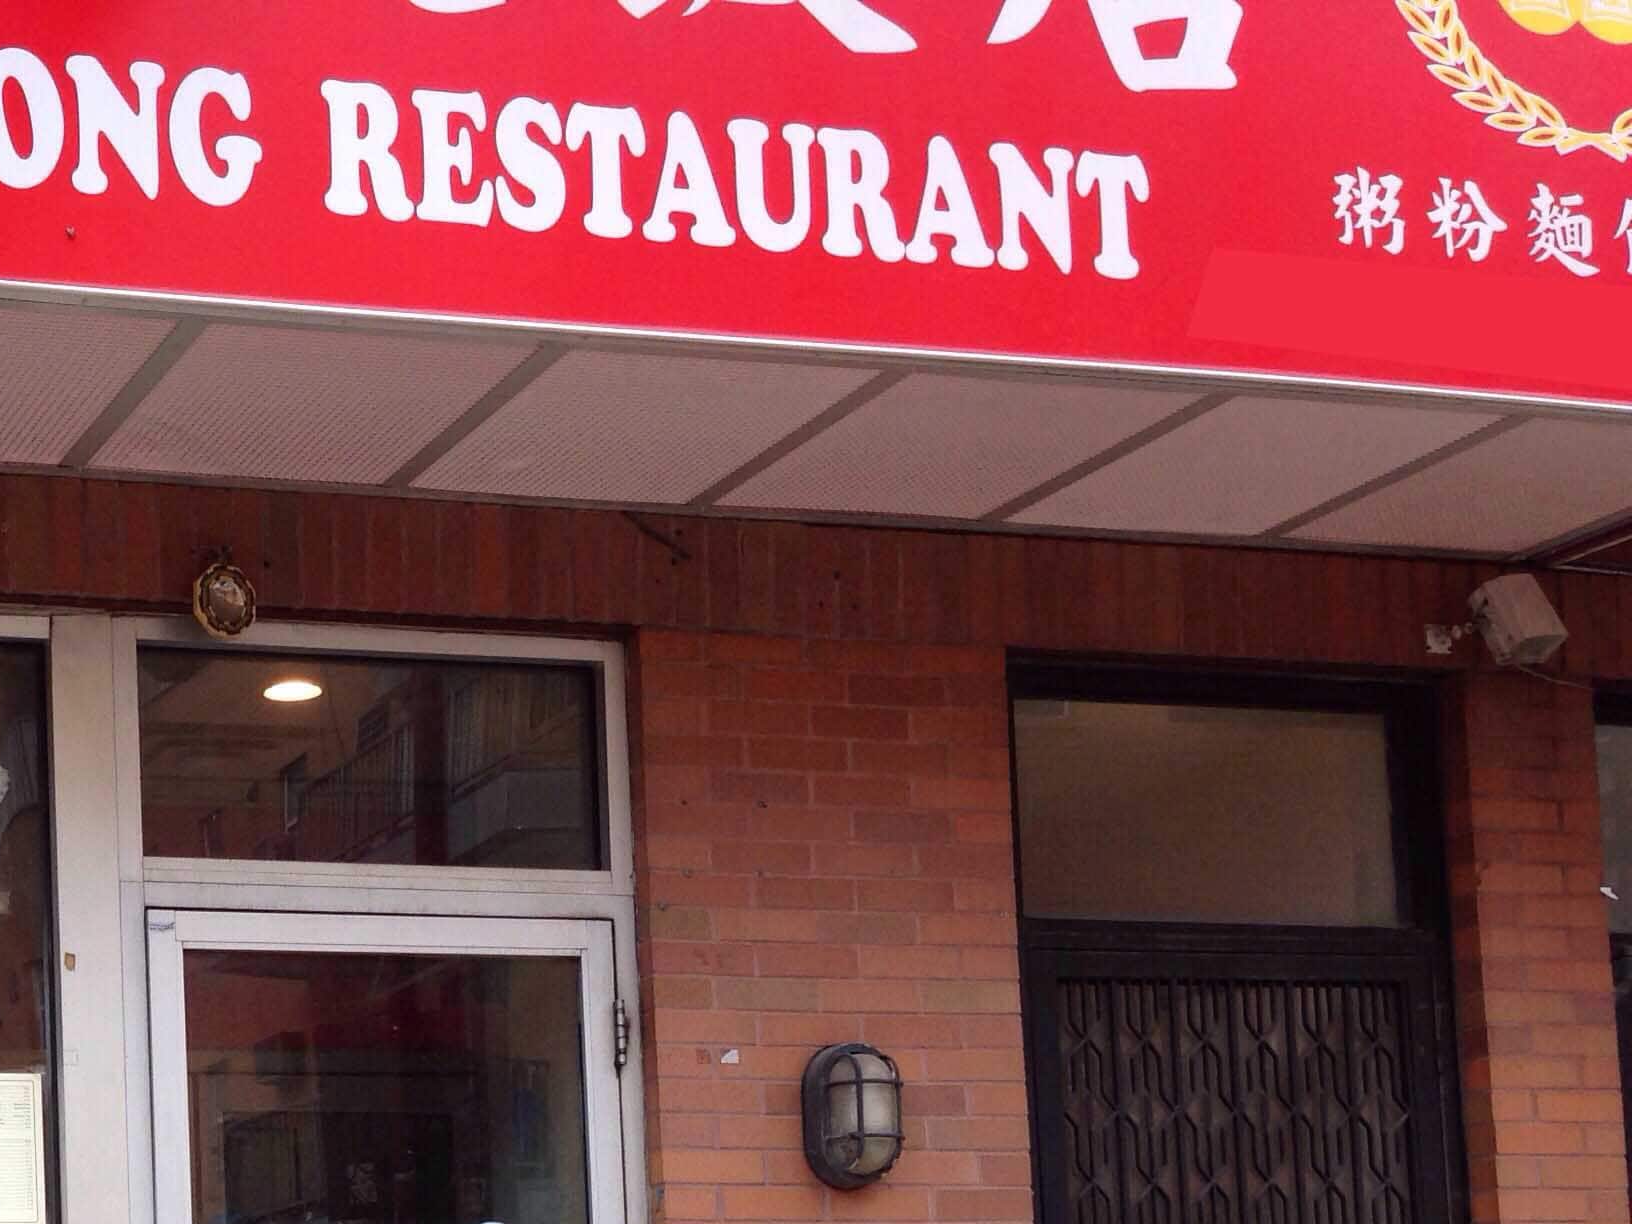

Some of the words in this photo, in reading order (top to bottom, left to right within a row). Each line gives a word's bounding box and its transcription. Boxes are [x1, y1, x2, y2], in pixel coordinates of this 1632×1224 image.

[320, 79, 1151, 280] RESTAURANT
[1332, 166, 1632, 277] 粥粉麵
